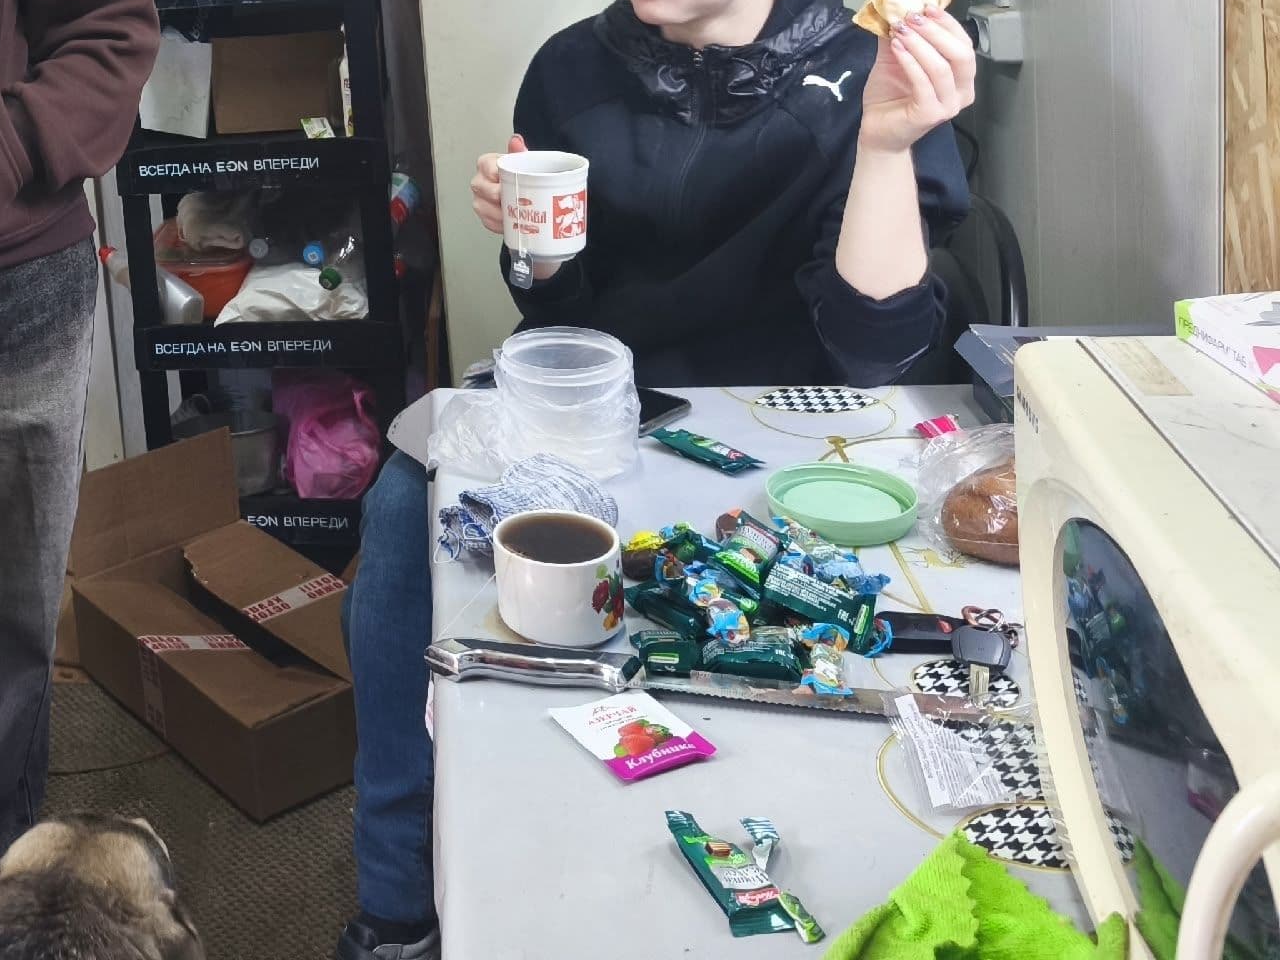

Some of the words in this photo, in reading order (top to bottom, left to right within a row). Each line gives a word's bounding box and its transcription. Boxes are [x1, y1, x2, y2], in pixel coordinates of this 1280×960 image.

[138, 162, 190, 177] ВСЕГДА
[192, 162, 212, 175] НА
[253, 157, 320, 171] ВПЕРЕДИ
[155, 342, 205, 356] ВСЕГДА
[207, 342, 226, 353] НА
[267, 340, 332, 353] ВПЕРЕДИ
[284, 515, 349, 529] ВПЕРЕДИ
